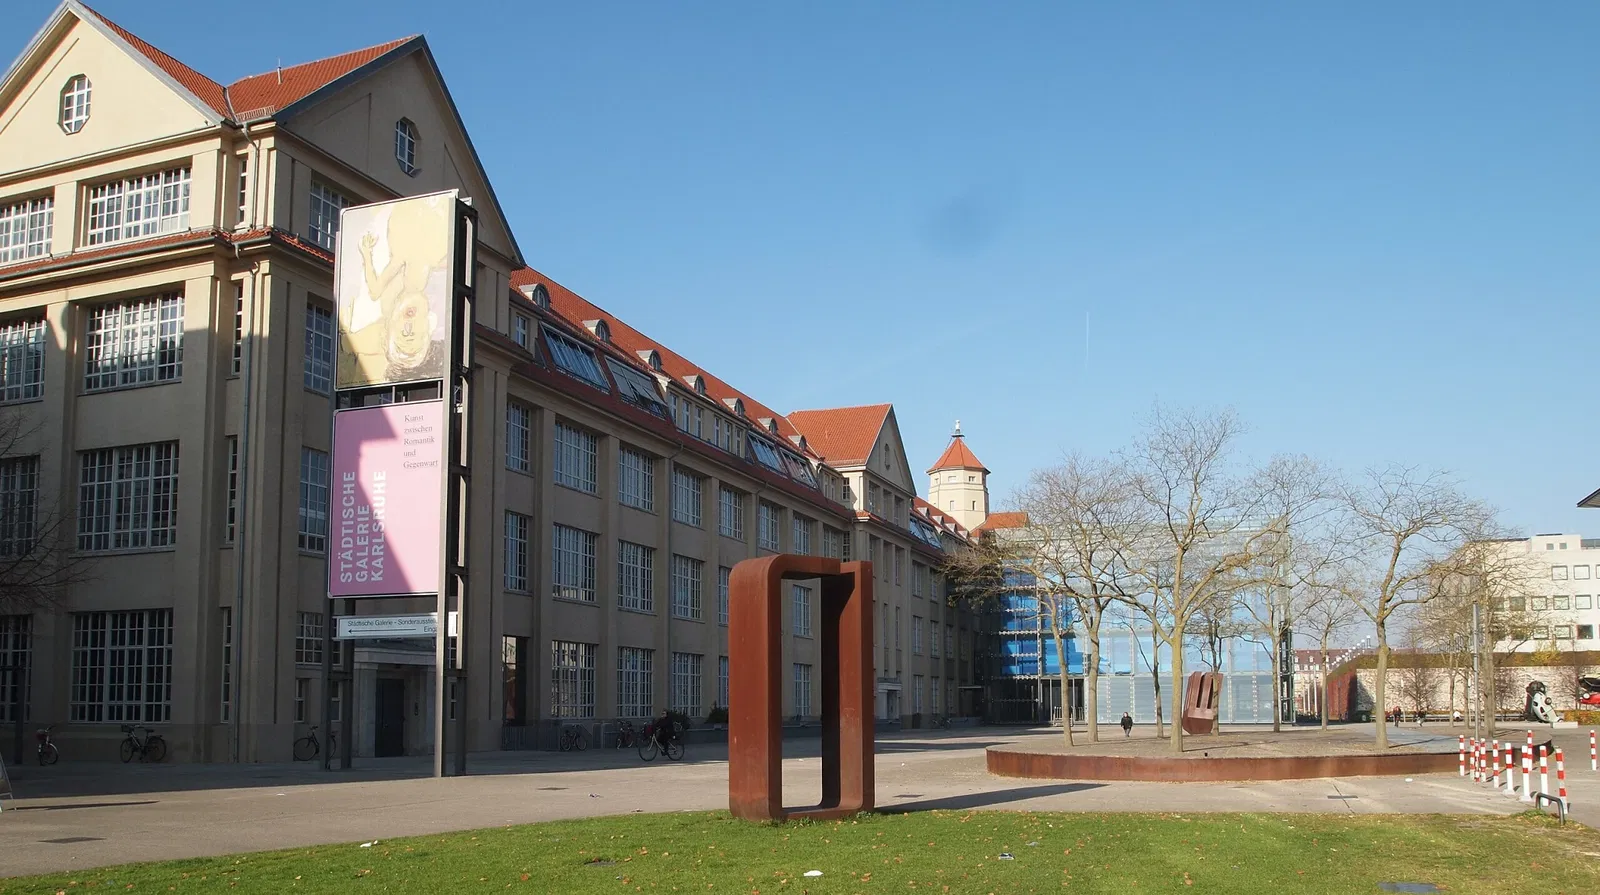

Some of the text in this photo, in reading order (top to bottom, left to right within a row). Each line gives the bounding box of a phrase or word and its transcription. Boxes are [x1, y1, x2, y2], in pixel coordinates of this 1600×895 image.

[403, 436, 436, 445] Romantik
[403, 449, 416, 457] und
[403, 460, 438, 469] Gegenwart
[338, 471, 355, 582] STÄDTISCHE
[356, 505, 369, 582] GALERIE
[371, 471, 386, 581] KARLSRUHE
